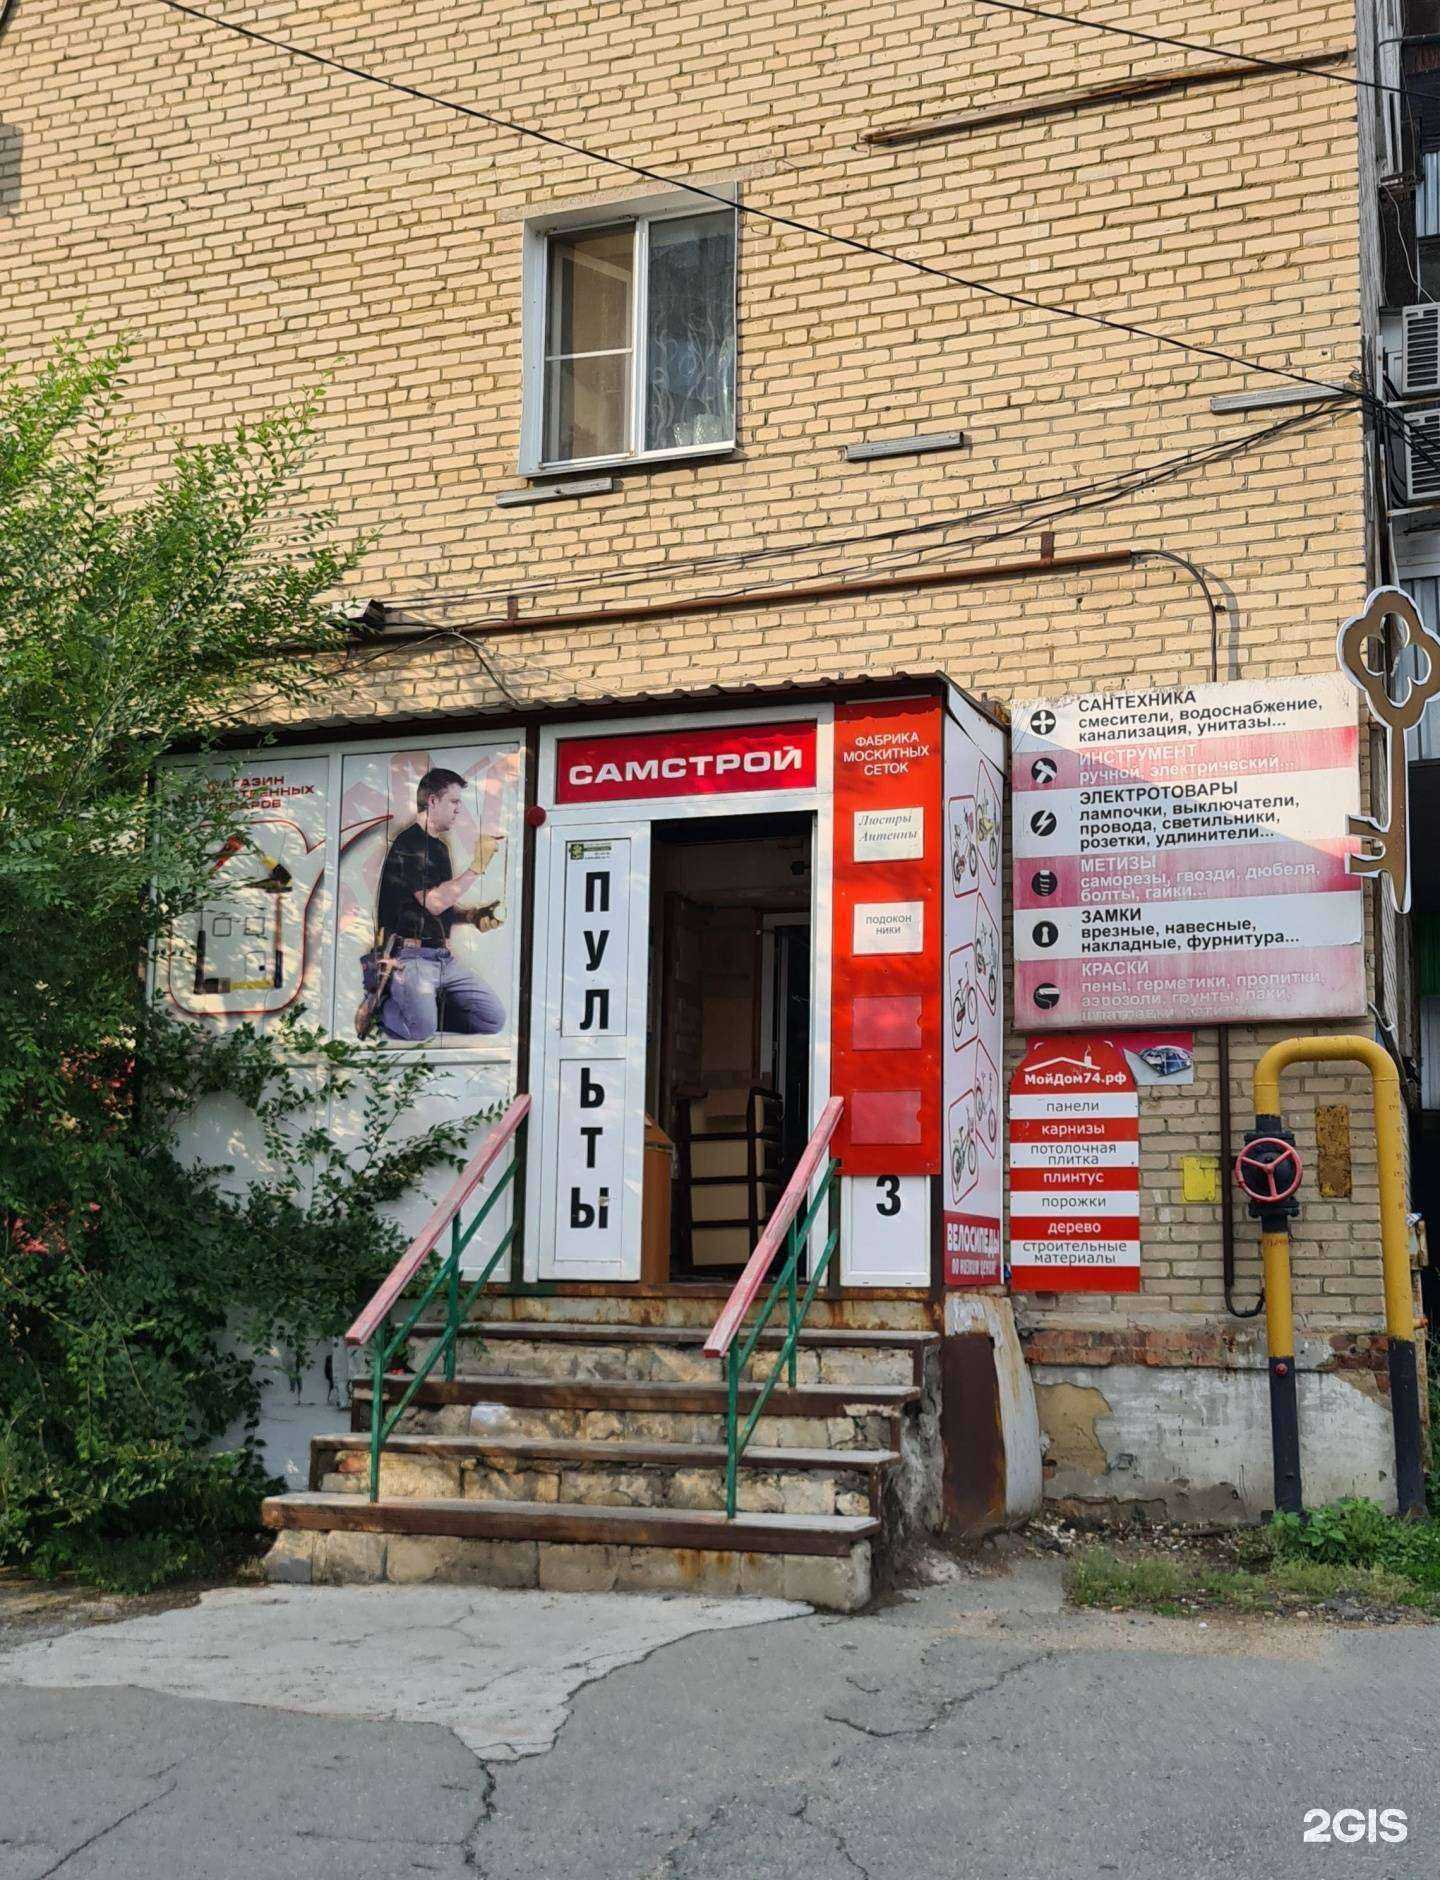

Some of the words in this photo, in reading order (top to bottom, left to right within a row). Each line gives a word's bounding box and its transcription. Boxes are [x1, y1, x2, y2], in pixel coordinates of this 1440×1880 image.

[1078, 690, 1196, 712] САНТЕХНИКА
[1078, 711, 1173, 729] смесители,
[1180, 697, 1323, 721] водоснабжение,
[1078, 721, 1192, 742] канализация,
[1197, 717, 1286, 736] унитазы...
[854, 731, 920, 748] ФАБРИКА
[843, 746, 930, 763] МОСКИТНЫХ
[1079, 743, 1197, 765] ИНСТРУМЕНТ
[568, 746, 803, 786] САМСТРОЙ
[864, 761, 909, 776] СЕТОК
[1079, 767, 1143, 785] ручной,
[1080, 781, 1238, 805] ЭЛЕКТРОТОВАРЫ
[1079, 805, 1168, 822] лампочки,
[1173, 795, 1300, 815] выключатели,
[858, 814, 913, 829] Люстры
[1079, 819, 1156, 837] провода,
[1162, 811, 1280, 831] светильники,
[858, 830, 918, 843] Антенны
[1080, 835, 1150, 852] розетки,
[1156, 827, 1275, 848] удлинители...
[1080, 856, 1157, 872] МЕТИЗЫ
[1080, 872, 1170, 890] саморезы,
[1080, 887, 1140, 904] болты,
[1081, 907, 1142, 924] ЗАМКИ
[1081, 924, 1159, 941] врезные,
[1165, 917, 1256, 935] навесные,
[1081, 936, 1181, 954] накладные,
[1187, 931, 1299, 951] фурнитура...
[1081, 961, 1150, 977] КРАСКИ
[570, 870, 611, 1230] ПУЛЬТЫ
[1024, 1072, 1127, 1086] МойДом74.рф
[1046, 1101, 1100, 1112] панели
[1041, 1124, 1105, 1137] карнизы
[1031, 1143, 1117, 1154] потолочная
[1048, 1155, 1099, 1165] плитка
[1043, 1172, 1104, 1184] плинтус
[1041, 1196, 1107, 1208] порожки
[1048, 1222, 1101, 1235] дерево
[1022, 1241, 1127, 1253] строительные
[1034, 1253, 1117, 1266] материалы
